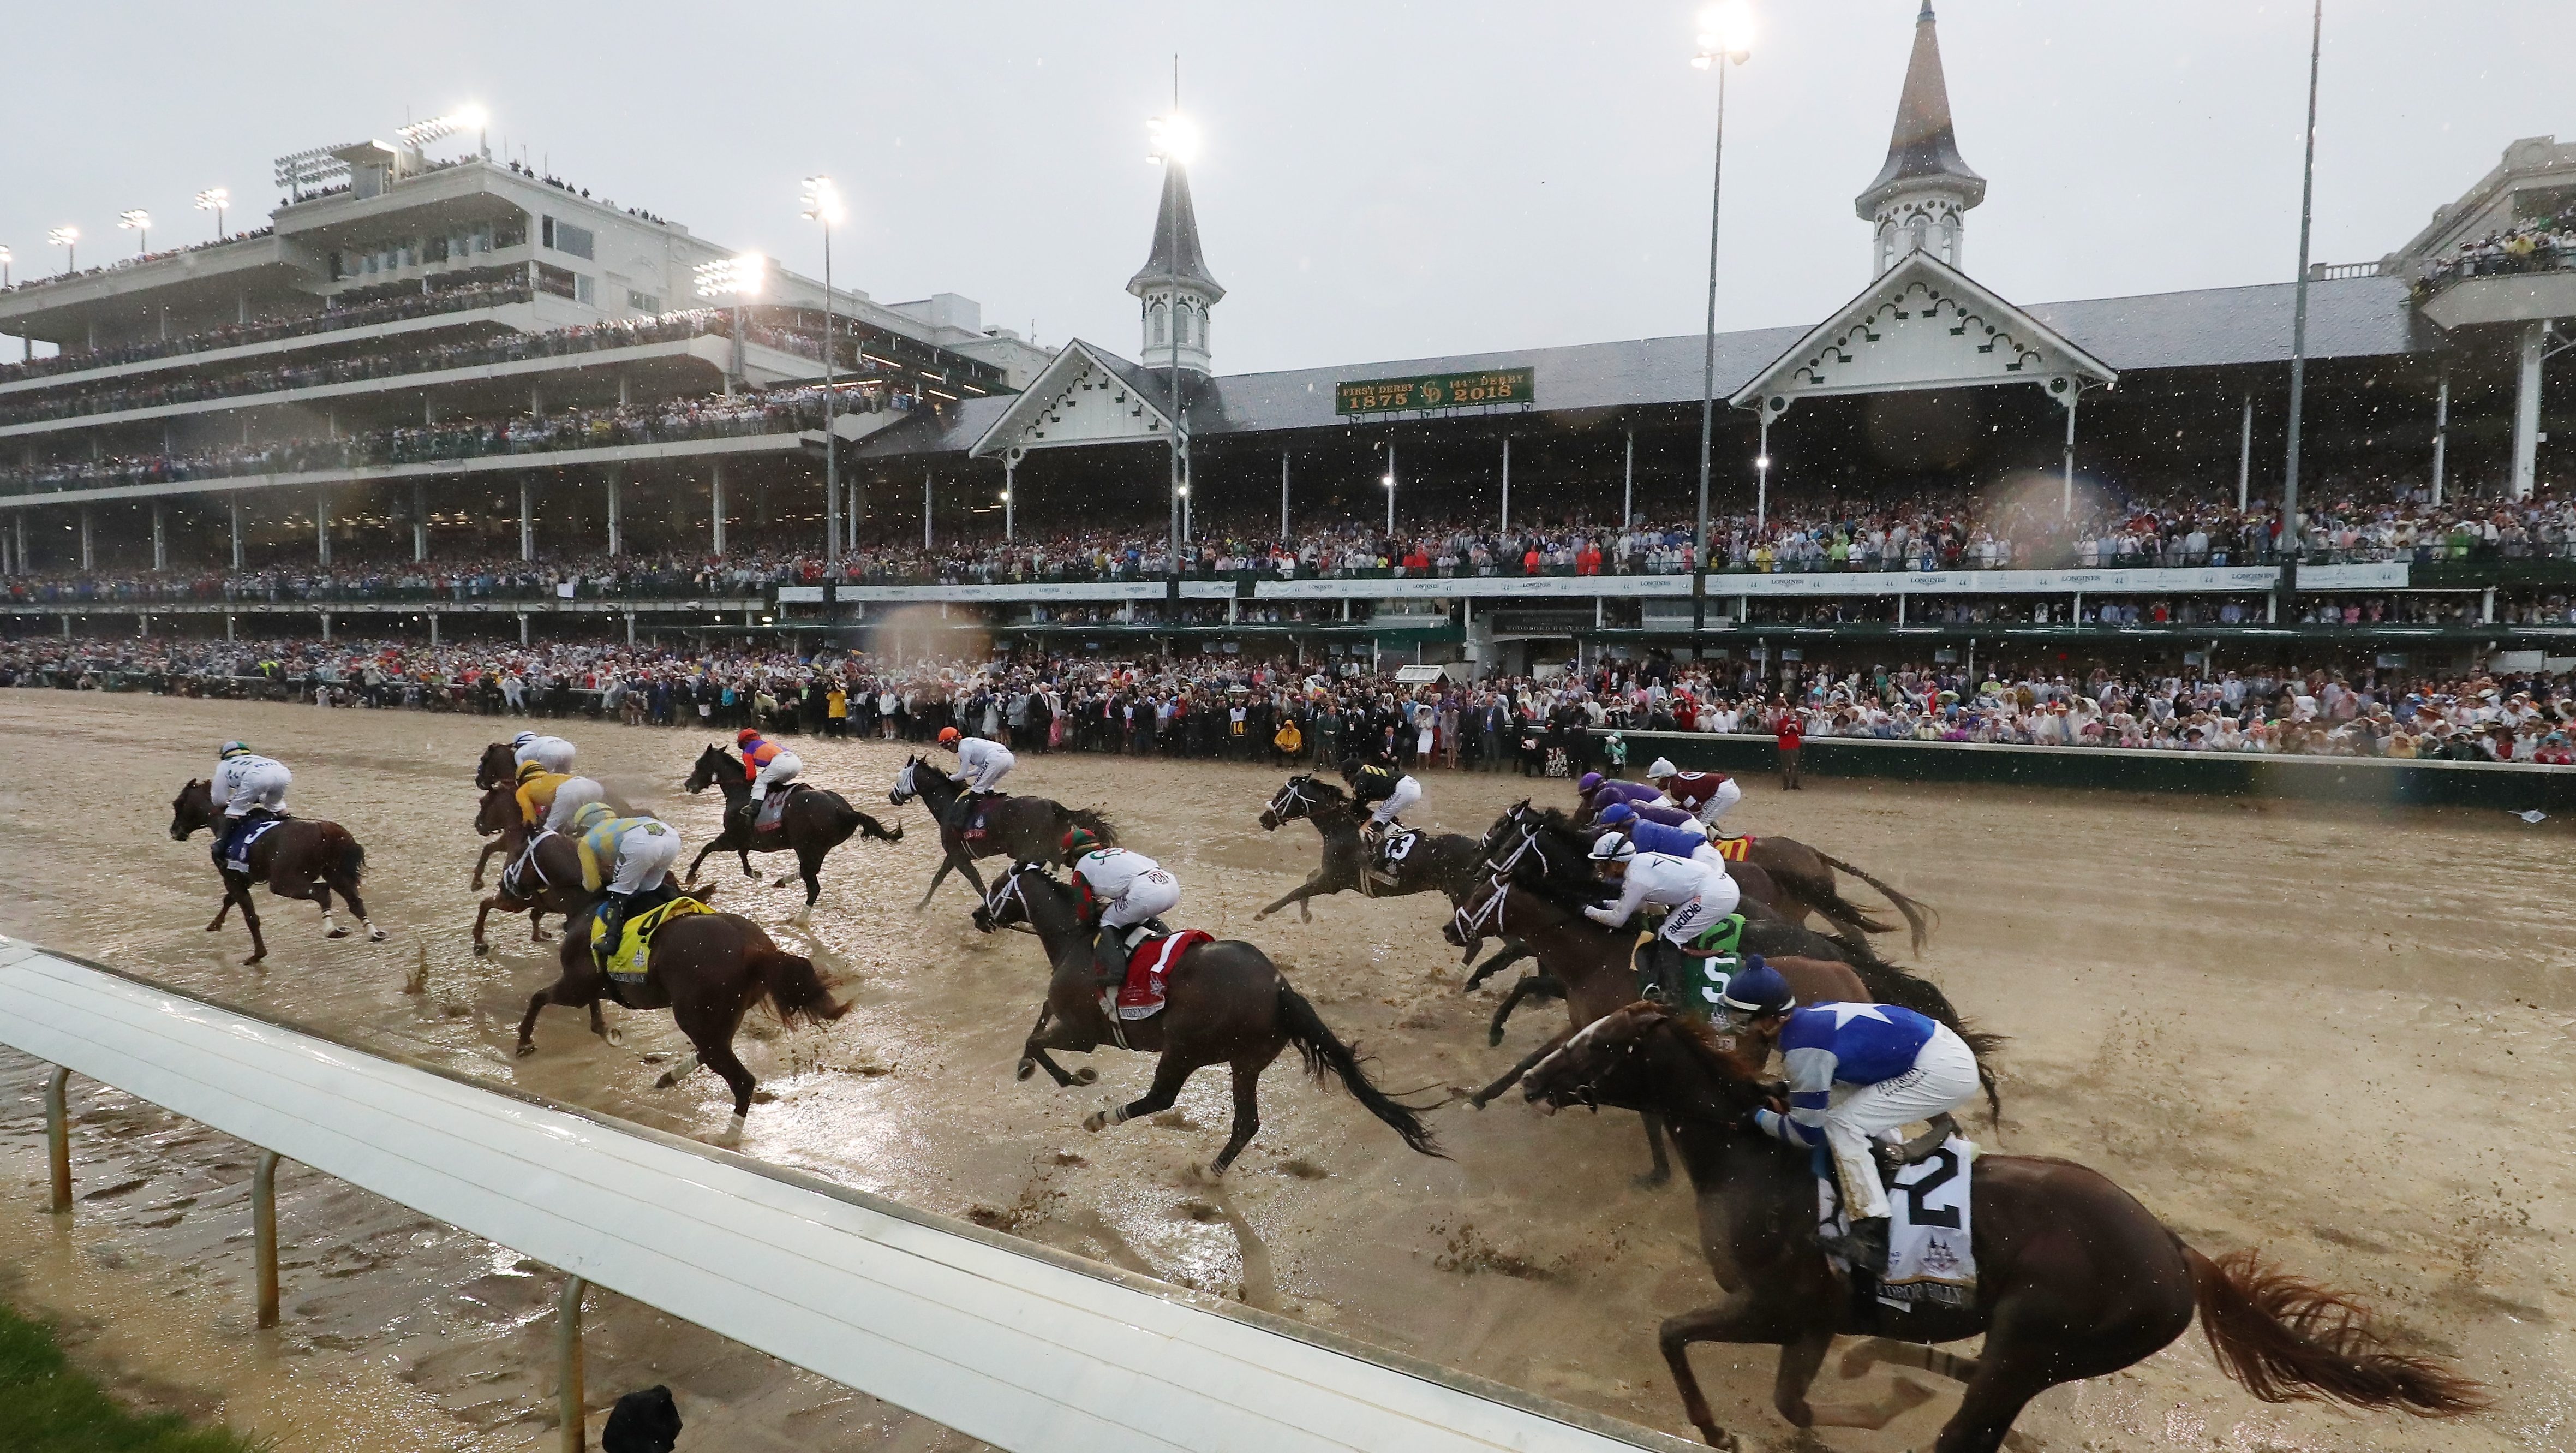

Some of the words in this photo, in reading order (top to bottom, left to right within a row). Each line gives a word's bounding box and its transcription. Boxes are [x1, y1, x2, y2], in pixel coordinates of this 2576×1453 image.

[1343, 386, 1374, 396] FIRST
[1379, 384, 1414, 394] DERBY
[1480, 375, 1524, 385] DERBY
[1349, 392, 1407, 409] 1875
[1455, 384, 1512, 401] 2018
[1233, 721, 1244, 735] 14
[244, 820, 281, 844] 3
[1667, 903, 1702, 934] audible
[1150, 931, 1185, 973] 1
[1701, 956, 1737, 1003] 5
[1892, 1147, 1961, 1229] 2
